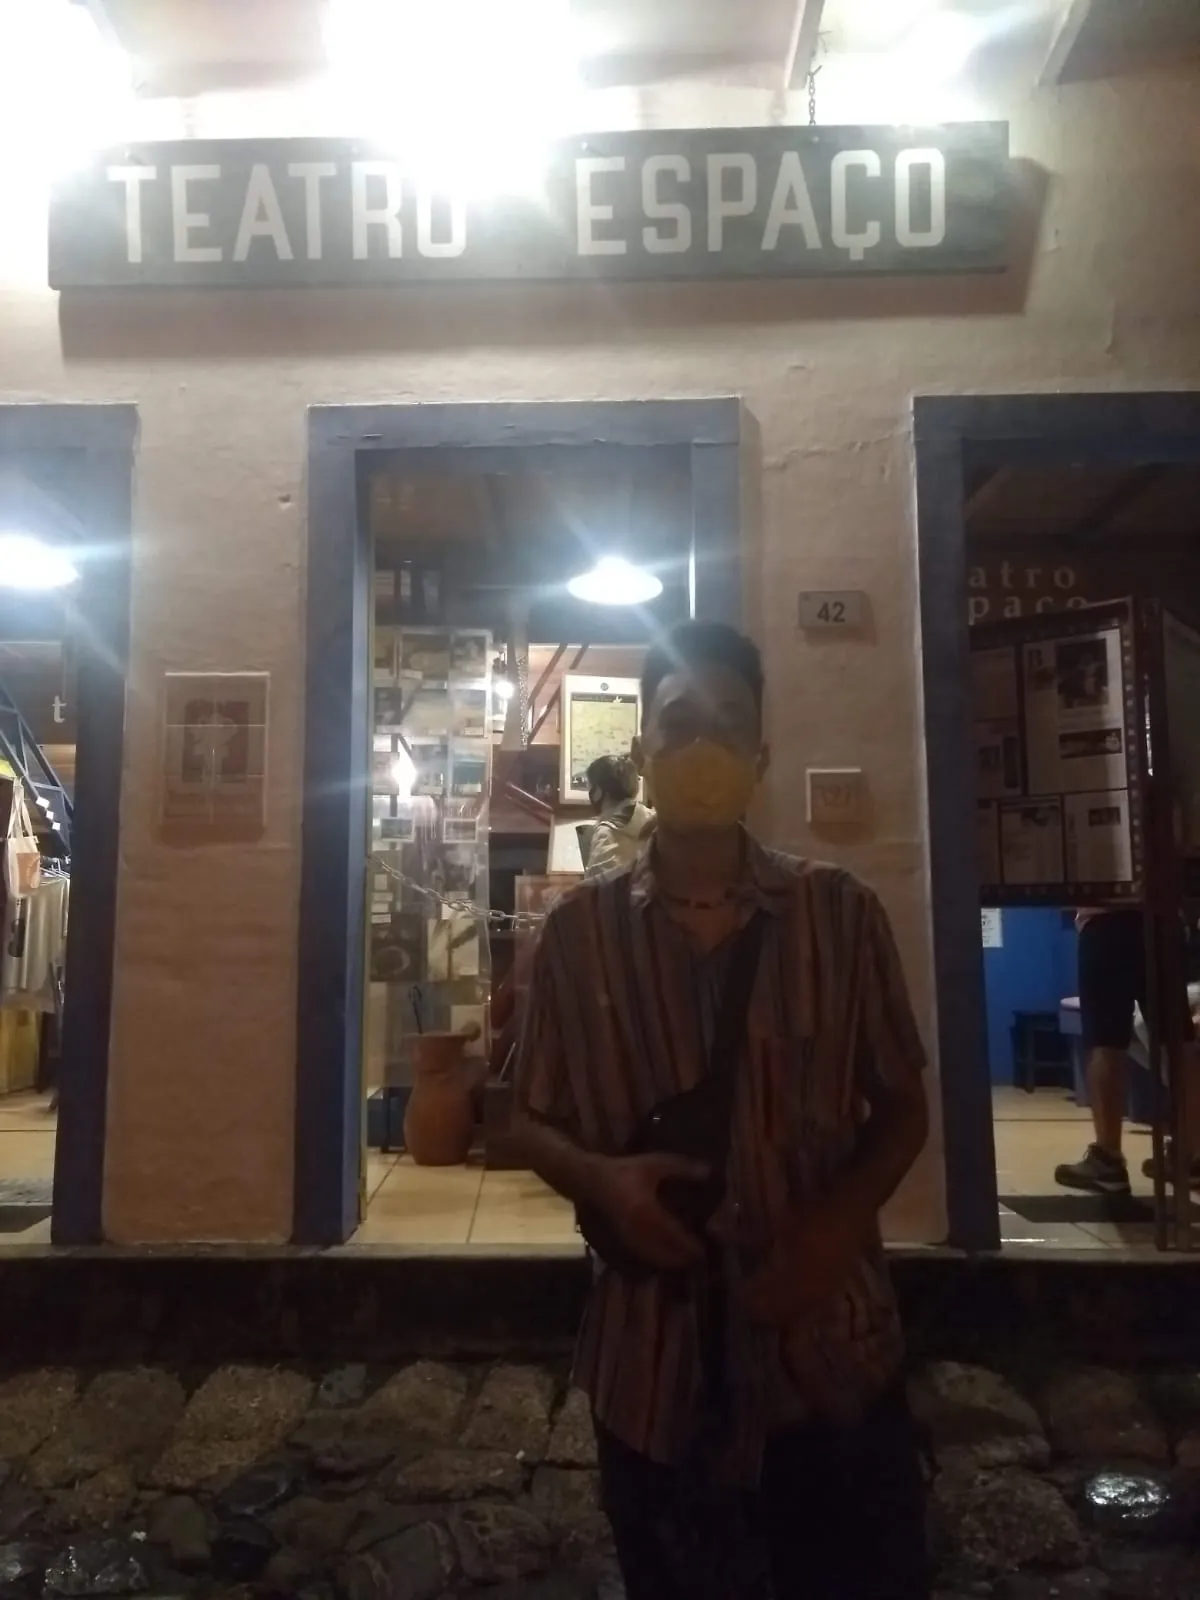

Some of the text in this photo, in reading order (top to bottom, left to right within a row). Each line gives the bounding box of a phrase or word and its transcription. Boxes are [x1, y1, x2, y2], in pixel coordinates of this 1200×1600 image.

[107, 147, 946, 263] TEATRO ESPAÇO
[816, 601, 846, 624] 42
